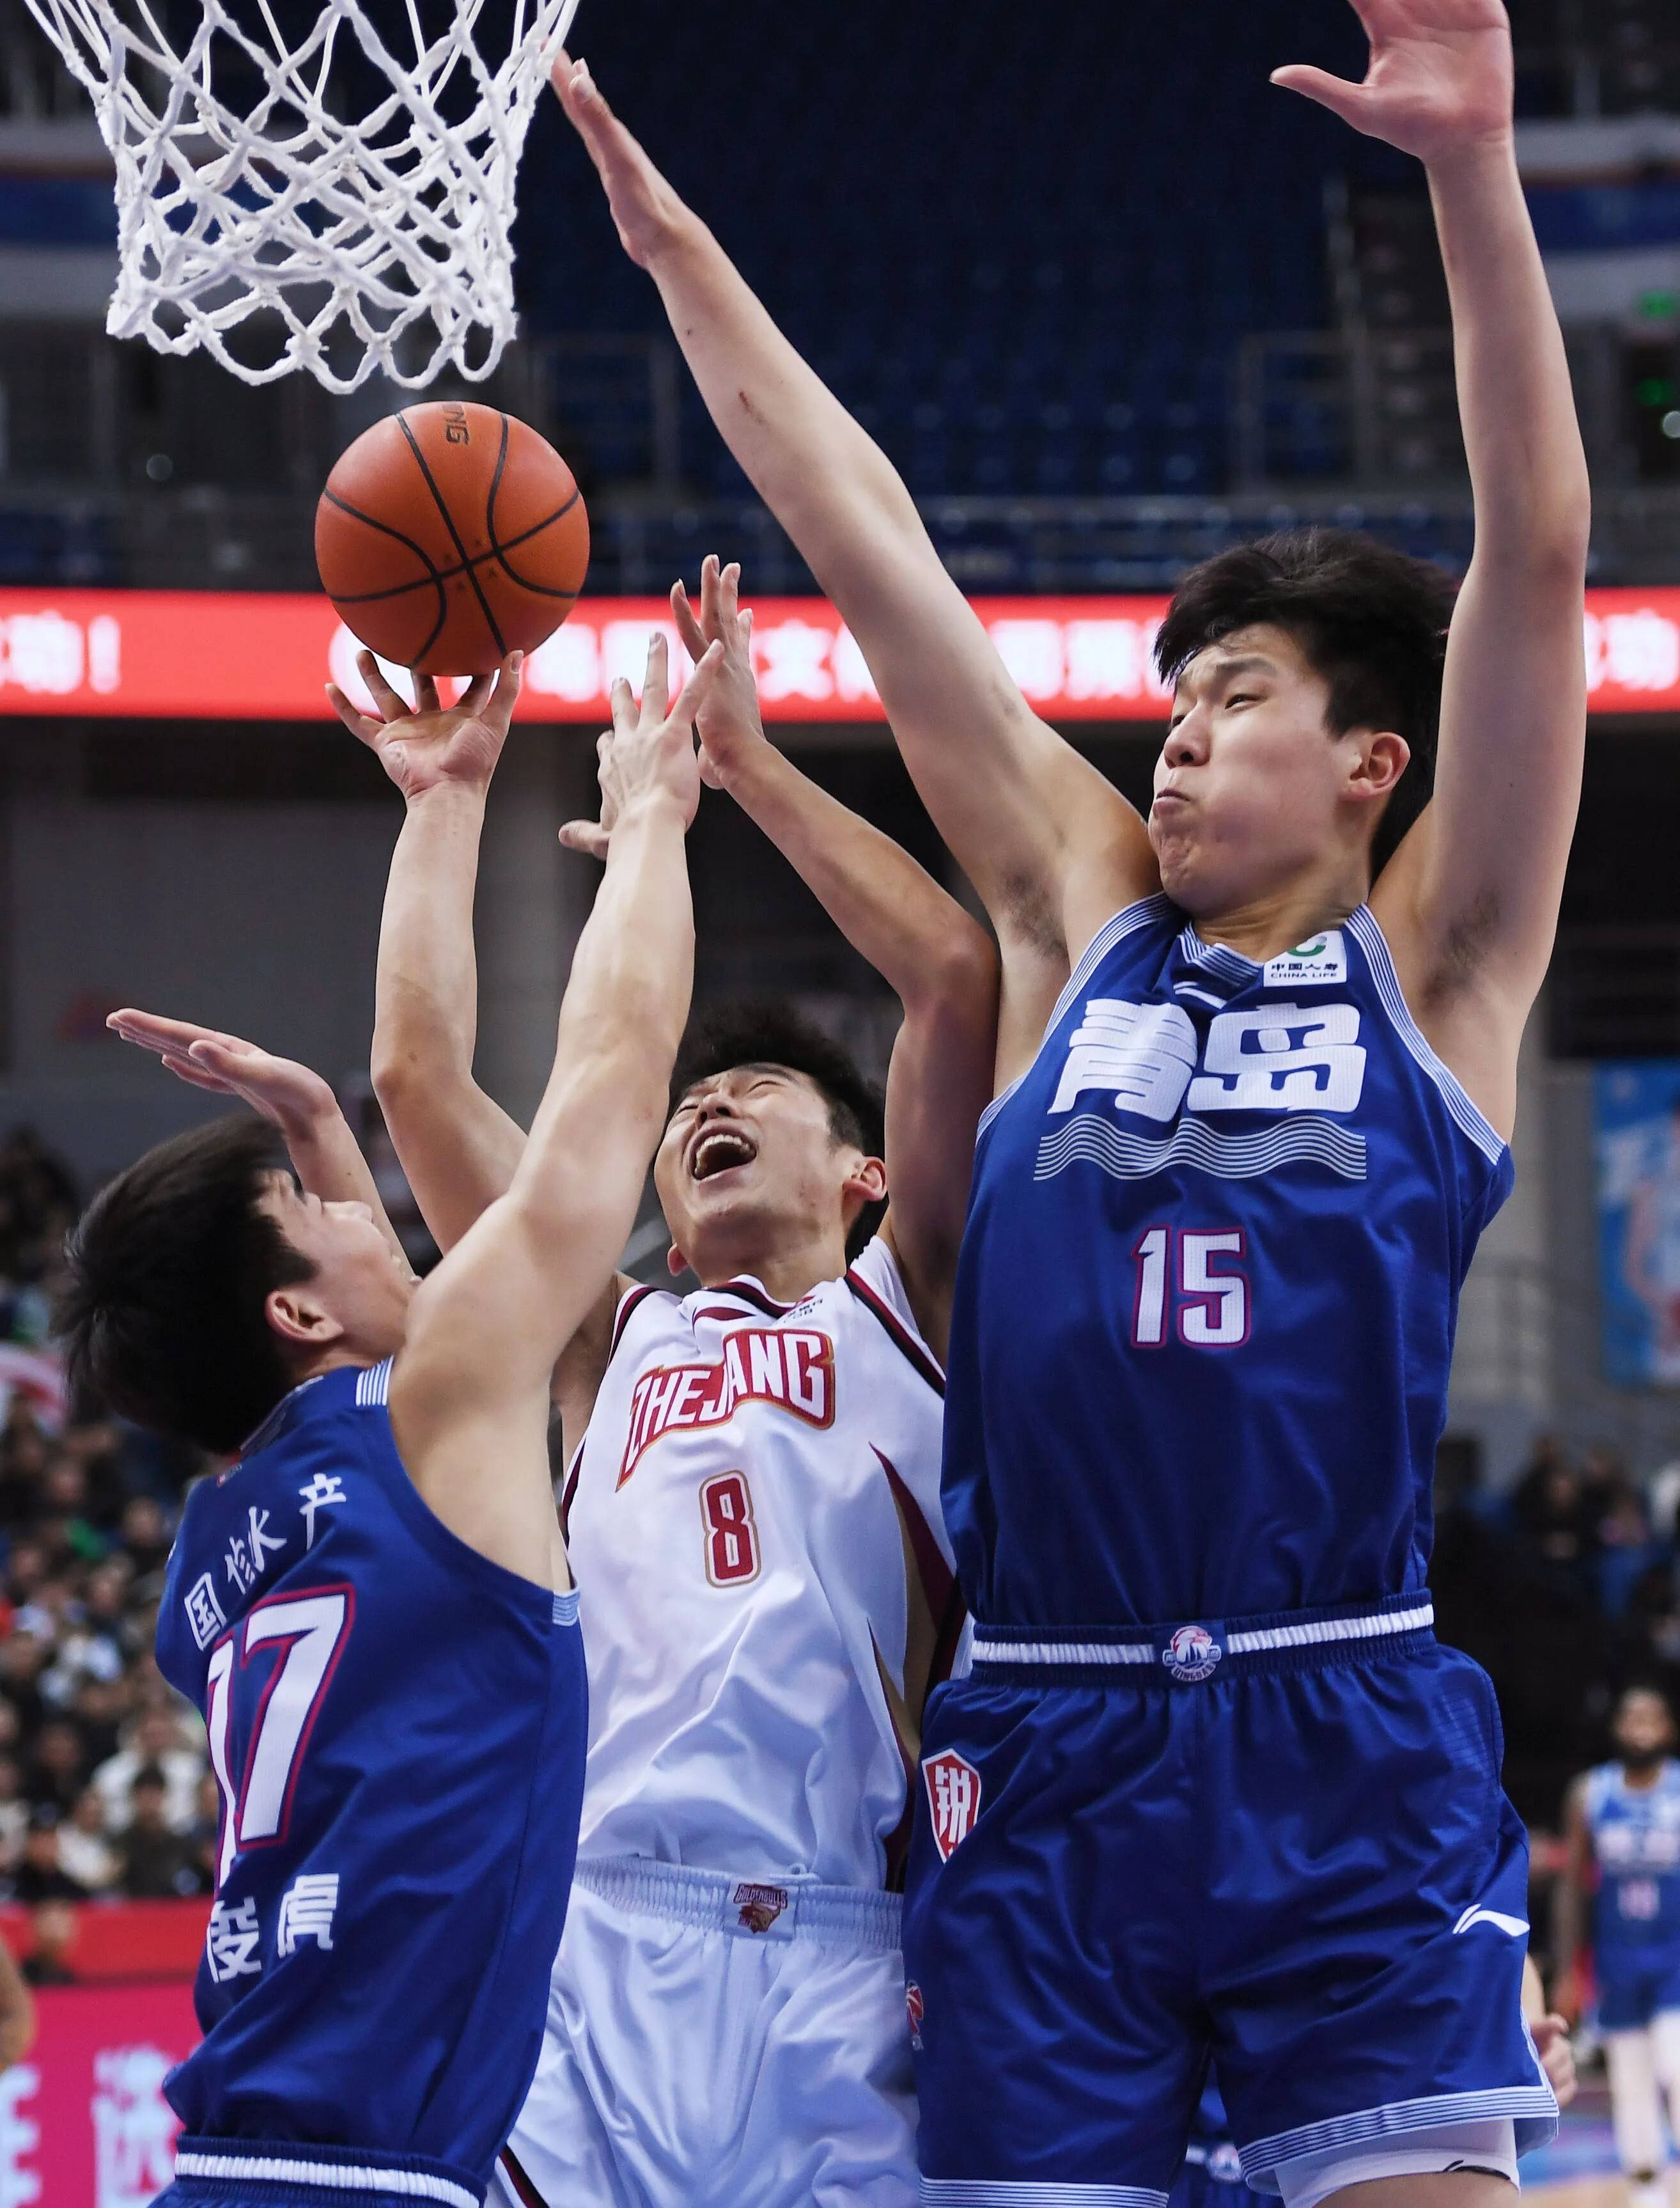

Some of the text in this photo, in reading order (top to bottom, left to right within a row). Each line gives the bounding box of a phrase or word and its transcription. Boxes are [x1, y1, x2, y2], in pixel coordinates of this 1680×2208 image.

[1272, 962, 1339, 971] 中国人寿
[1047, 998, 1367, 1123] 青岛
[1132, 1225, 1249, 1347] 15
[703, 1473, 758, 1585] 8
[206, 1587, 354, 1890] 17
